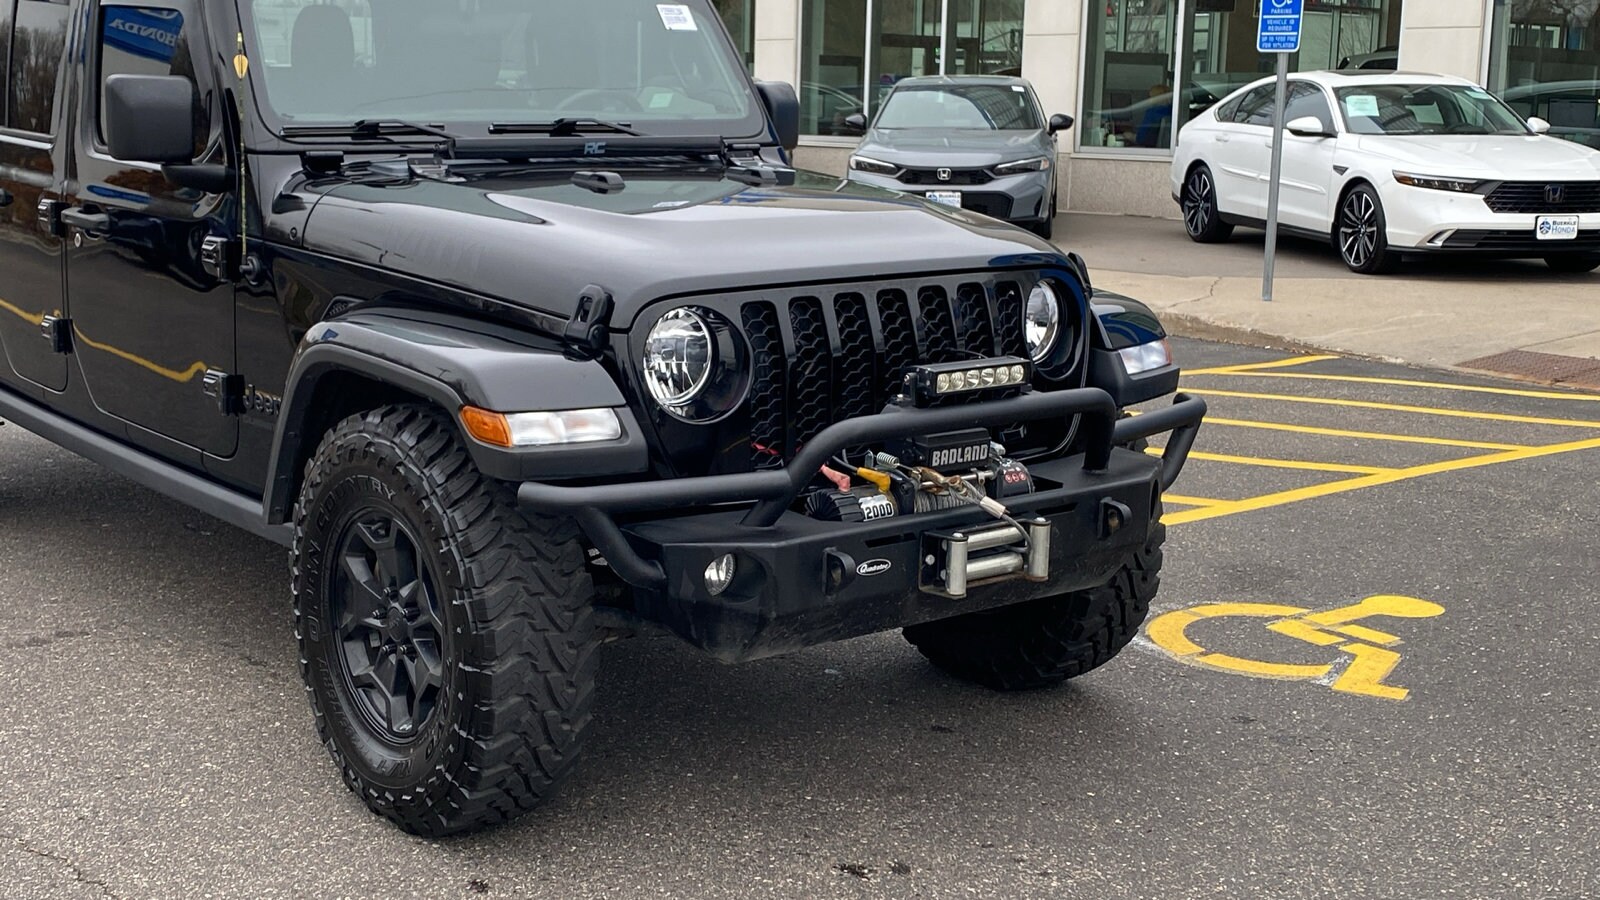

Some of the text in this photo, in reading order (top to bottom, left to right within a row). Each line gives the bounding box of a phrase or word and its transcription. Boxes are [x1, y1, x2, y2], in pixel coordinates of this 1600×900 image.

[584, 142, 606, 154] RC
[1551, 225, 1576, 234] HONDA
[932, 444, 988, 467] BADLAND
